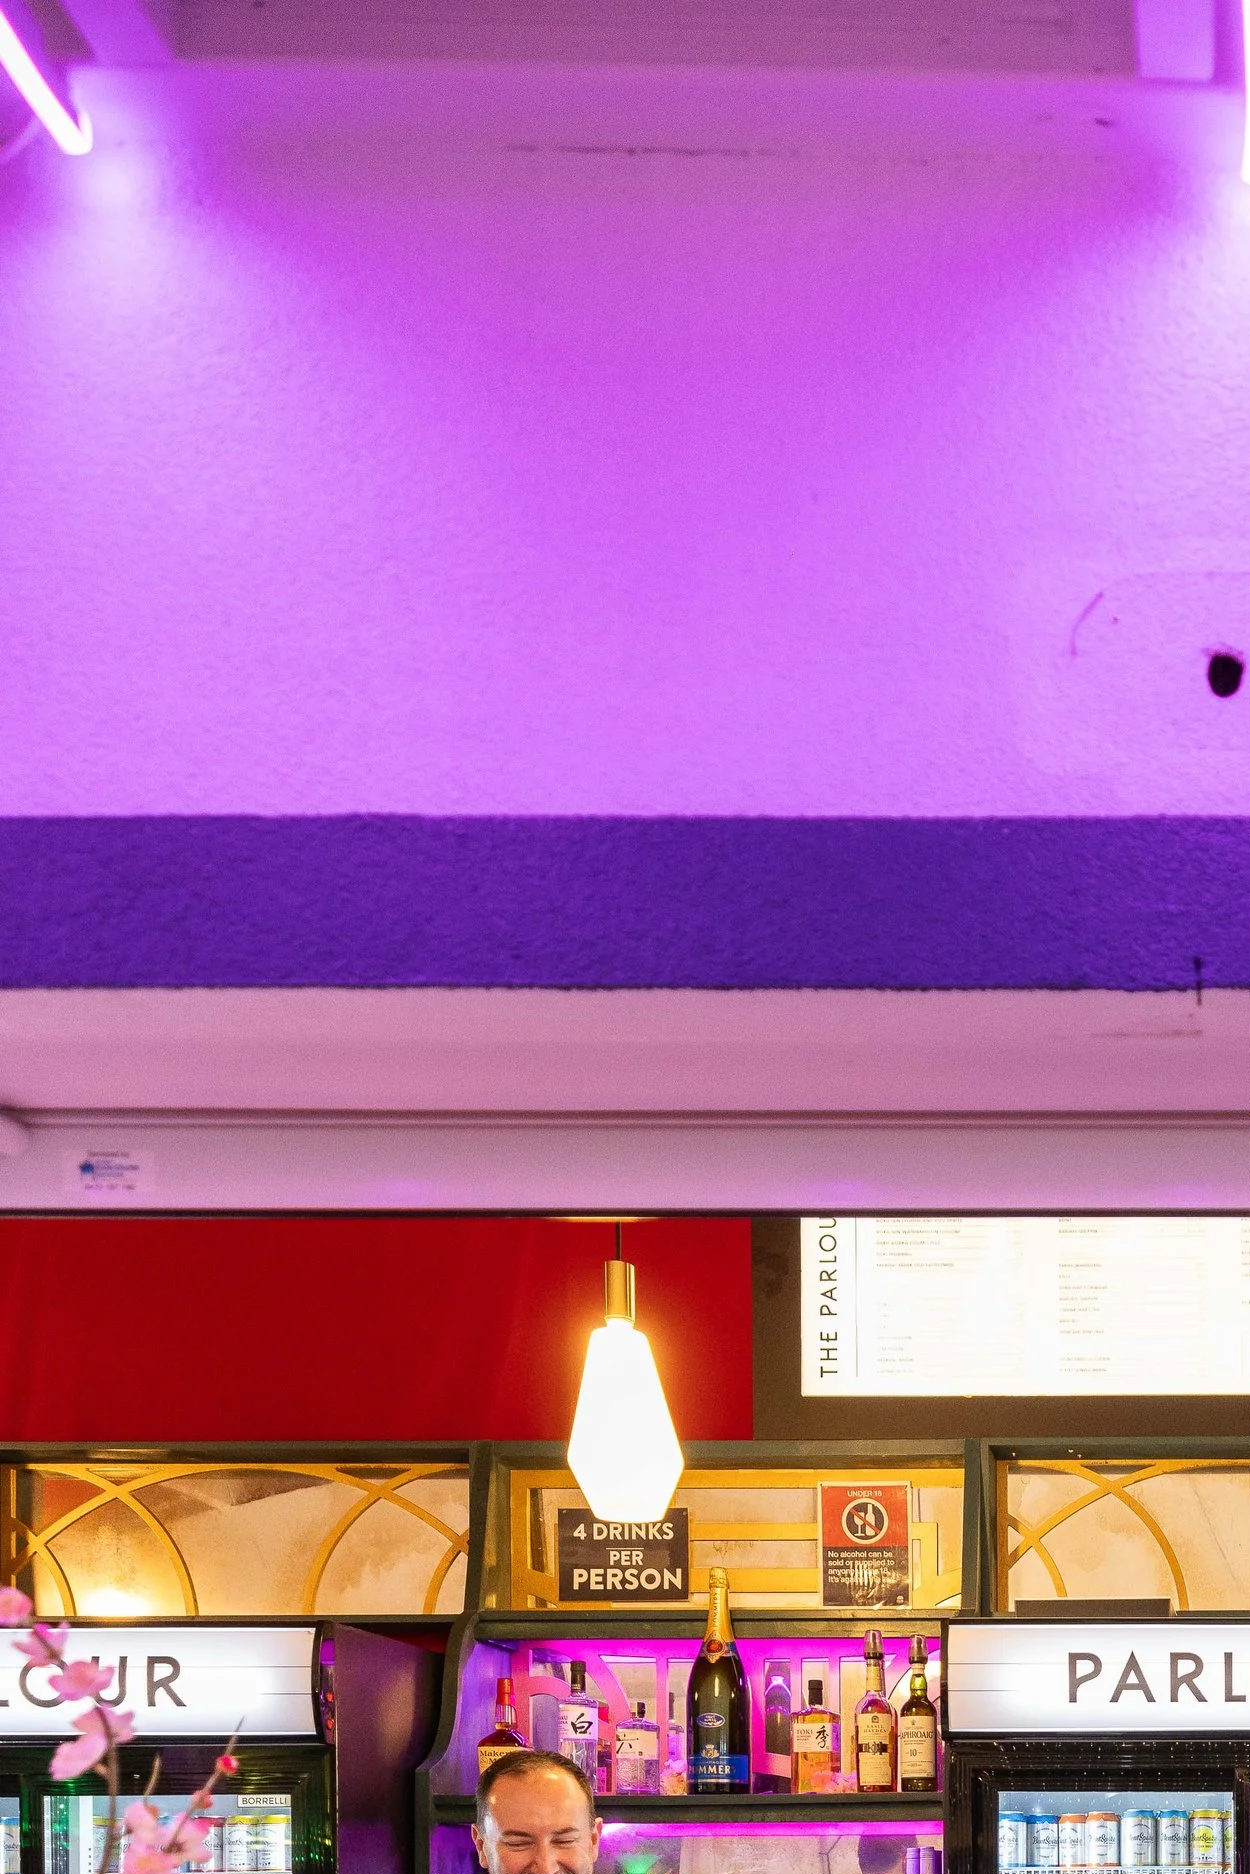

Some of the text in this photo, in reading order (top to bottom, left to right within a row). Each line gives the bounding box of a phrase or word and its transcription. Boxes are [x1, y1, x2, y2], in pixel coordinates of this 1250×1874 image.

[819, 1331, 838, 1378] THE
[573, 1522, 674, 1540] 4 DRINKS
[609, 1550, 643, 1566] PER
[828, 1550, 838, 1558] No
[840, 1550, 867, 1558] alcohol
[883, 1550, 893, 1558] be
[572, 1567, 682, 1590] PERSON
[0, 1655, 187, 1708] OUR
[480, 1750, 508, 1758] Maker
[909, 1748, 917, 1757] 10
[242, 1797, 287, 1805] BORRELLI
